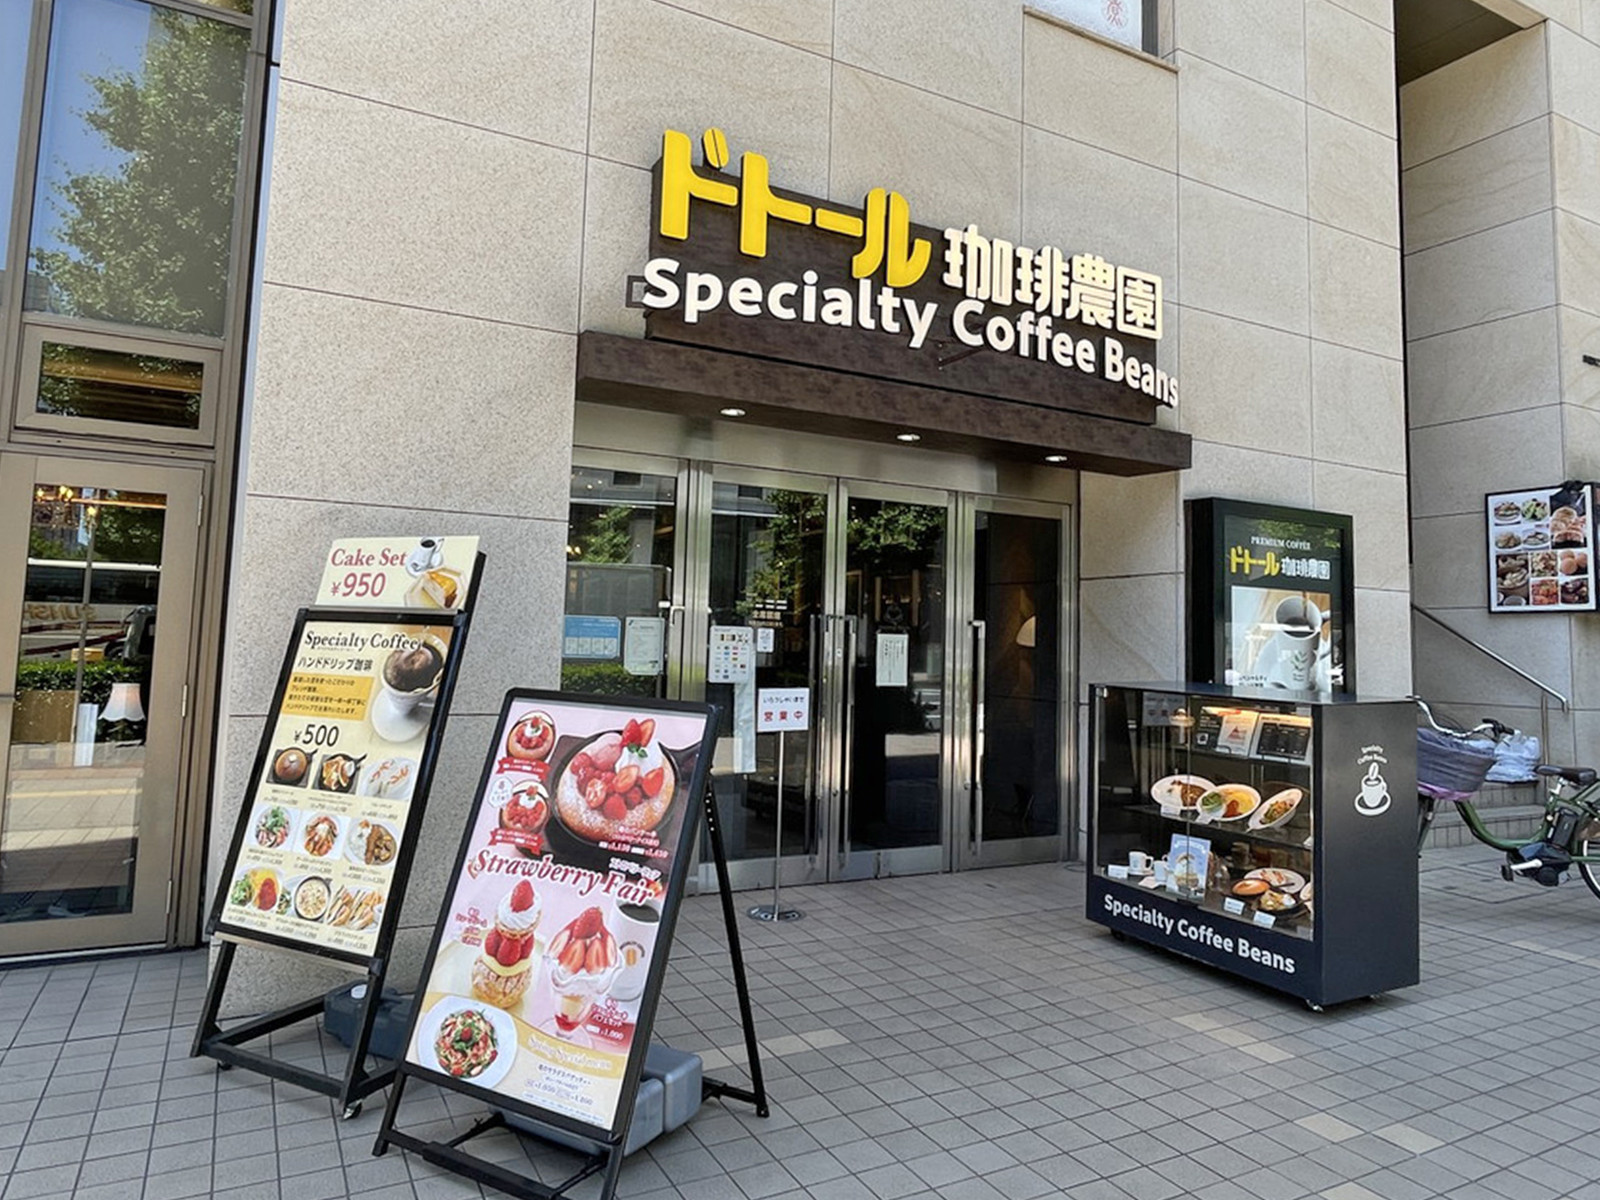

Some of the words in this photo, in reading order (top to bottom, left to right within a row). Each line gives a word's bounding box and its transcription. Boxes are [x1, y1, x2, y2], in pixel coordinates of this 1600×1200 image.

[660, 127, 931, 287] ドトール
[942, 224, 1163, 340] 珈琲農園
[642, 257, 938, 348] Specialty
[952, 300, 1096, 373] Coffee
[1104, 336, 1179, 408] Beans
[331, 548, 375, 567] Cake
[379, 548, 407, 567] Set
[1229, 545, 1280, 577] ドトール
[331, 572, 387, 598] ¥950
[304, 630, 370, 652] Specialty
[370, 632, 418, 650] Coffee
[764, 710, 804, 723] 営業中
[293, 724, 340, 747] ¥500
[475, 849, 602, 897] Strawberry
[602, 871, 654, 905] Fair
[1104, 893, 1174, 936] Specialty
[1177, 919, 1234, 952] Coffee
[1238, 937, 1296, 974] Beans
